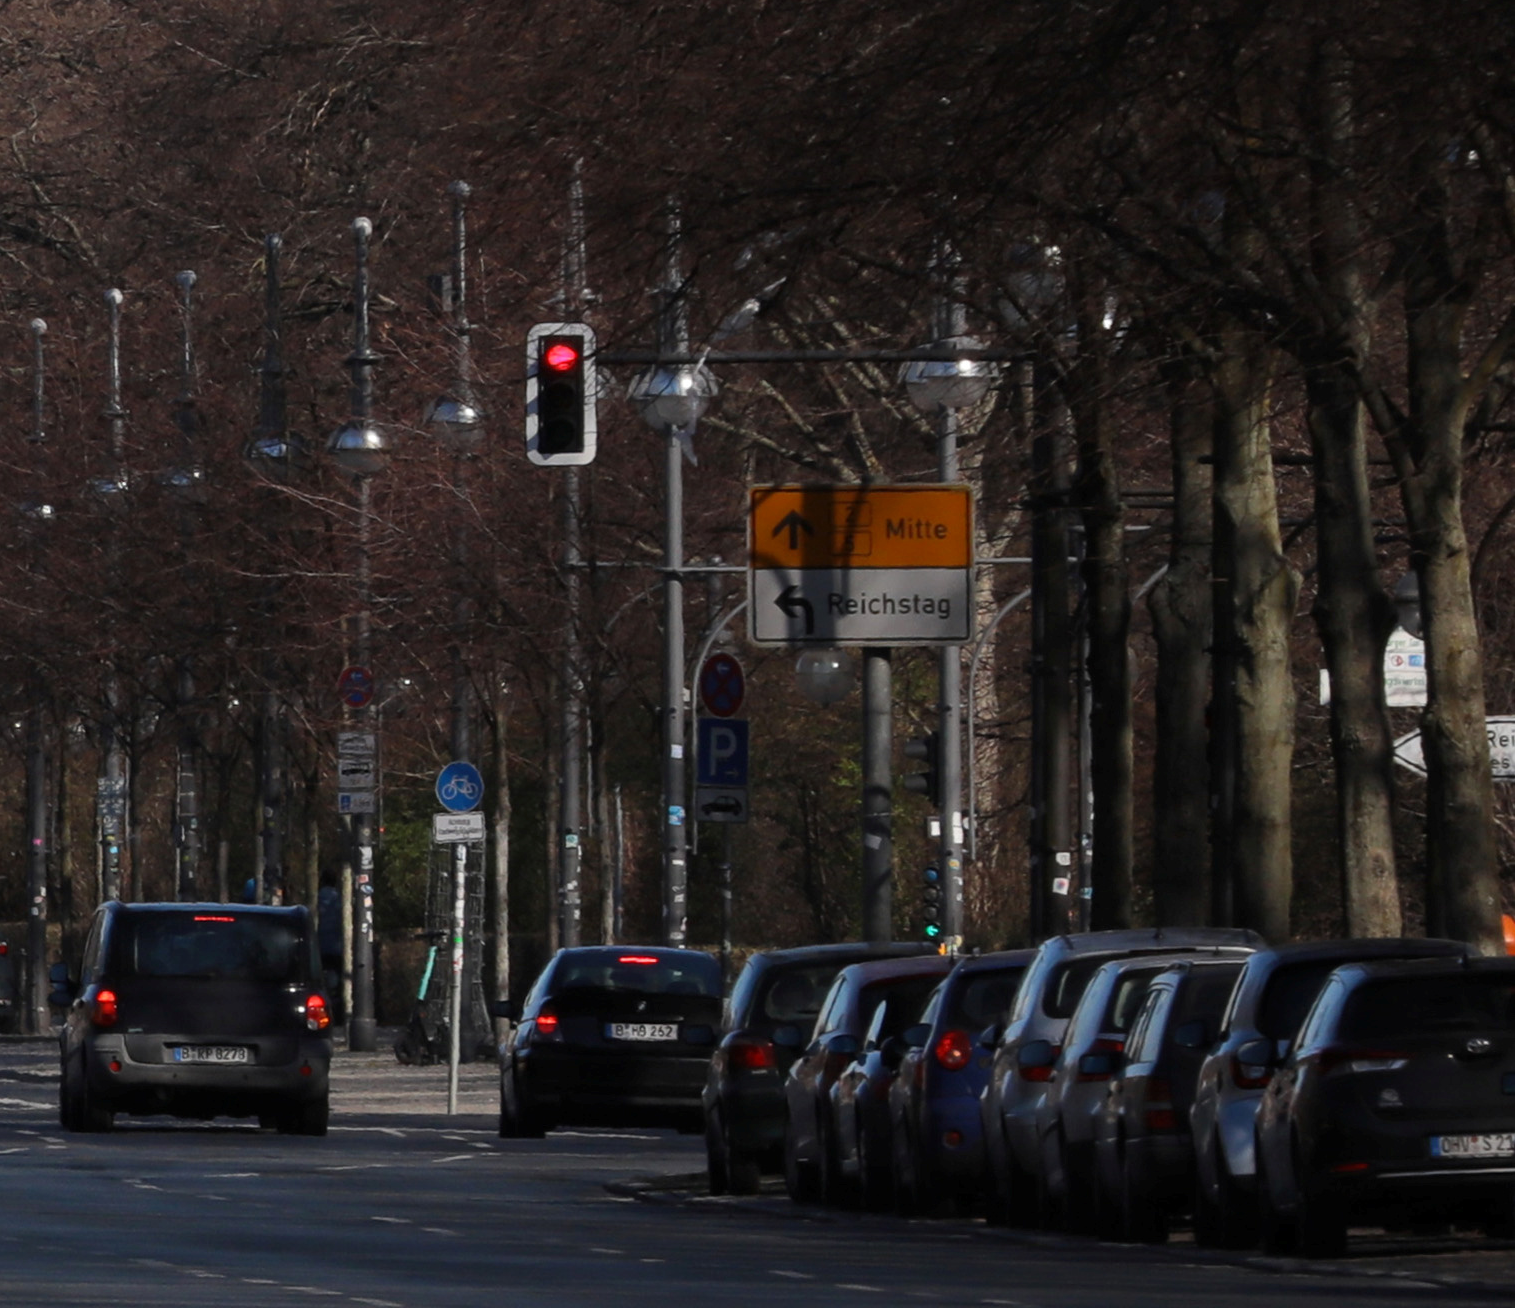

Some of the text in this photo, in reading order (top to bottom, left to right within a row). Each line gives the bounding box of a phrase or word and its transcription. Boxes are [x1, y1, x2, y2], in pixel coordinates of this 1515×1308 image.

[885, 518, 948, 540] Mitte
[827, 592, 951, 619] Reichstag
[710, 726, 737, 776] P
[1482, 1134, 1493, 1151] S
